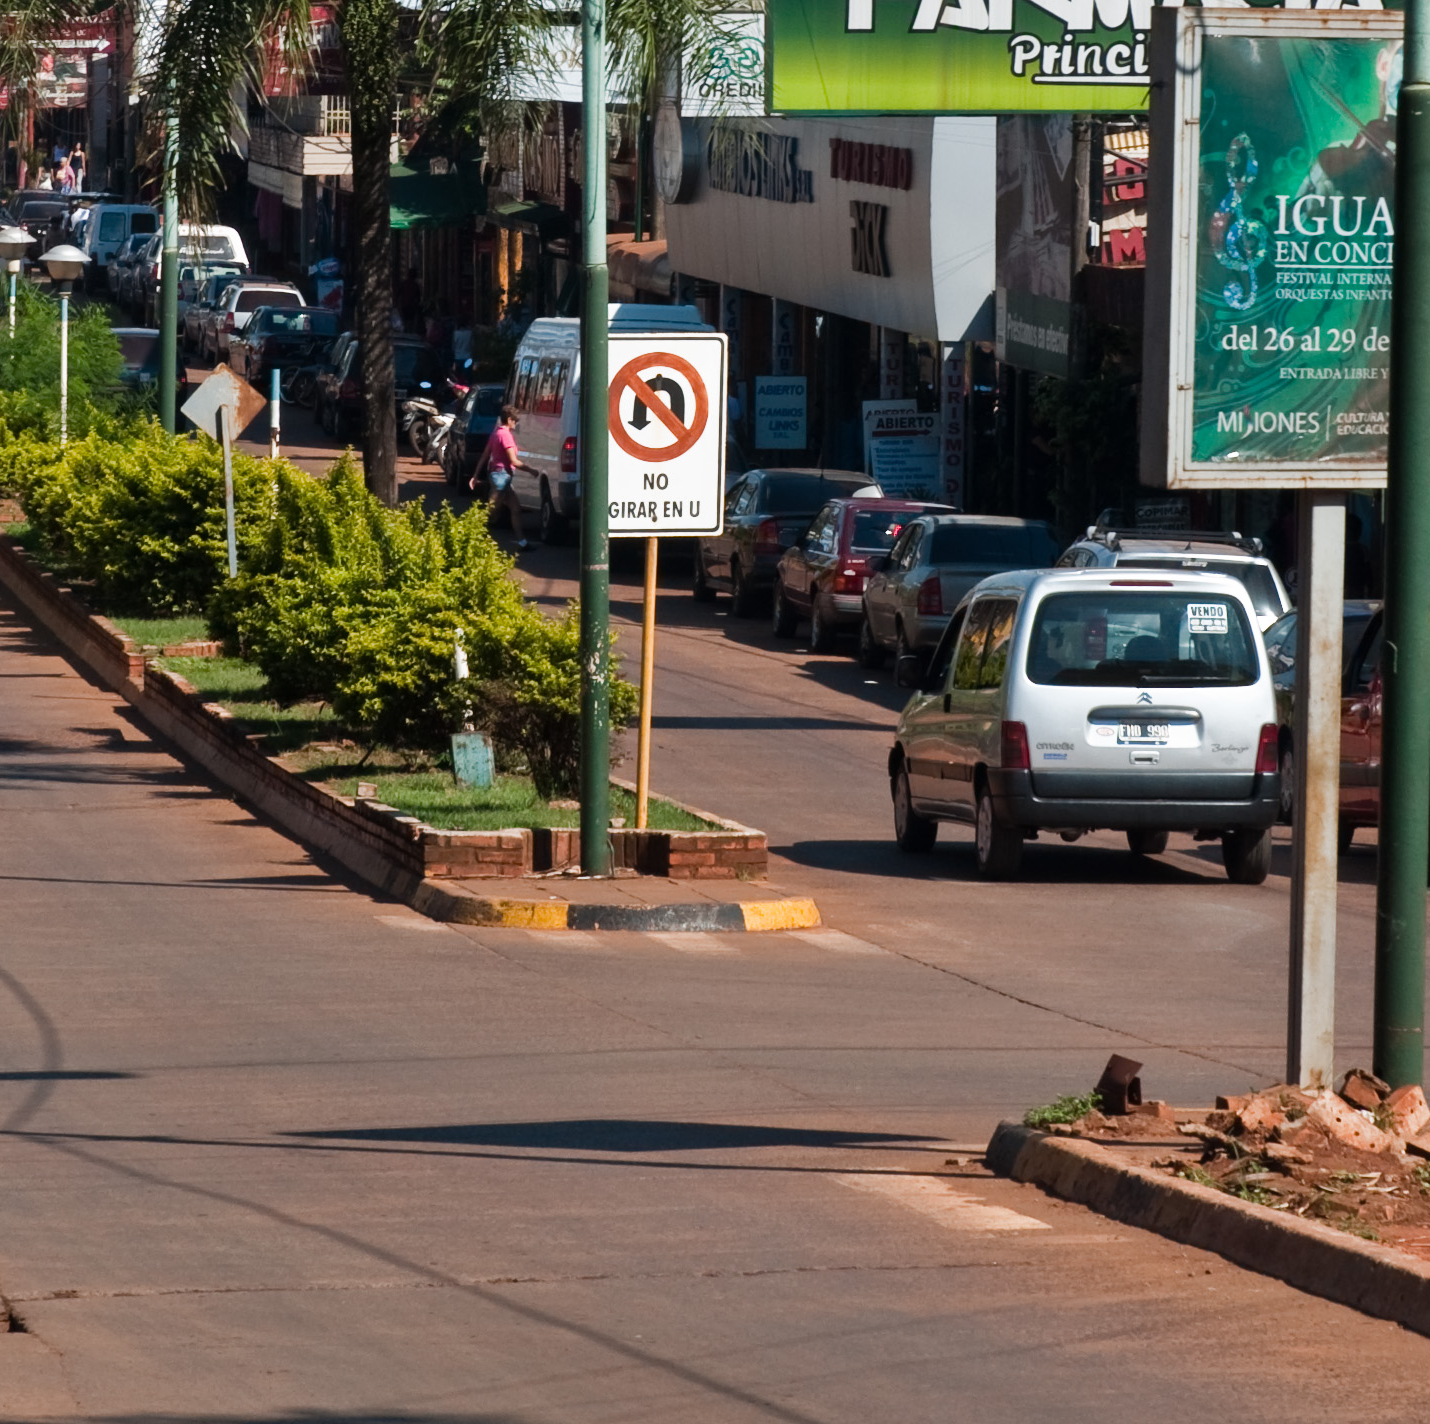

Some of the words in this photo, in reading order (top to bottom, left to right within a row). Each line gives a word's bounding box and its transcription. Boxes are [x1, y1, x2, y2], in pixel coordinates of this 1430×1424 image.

[1009, 33, 1150, 76] Princi
[829, 137, 913, 191] TURISMO
[1275, 241, 1308, 262] EN
[1276, 273, 1334, 284] FESTIVAL
[1337, 273, 1392, 285] INTERNA
[1275, 288, 1344, 300] ORQUESTAS
[1222, 326, 1258, 351] del
[1263, 327, 1295, 351] 26
[1300, 326, 1321, 352] al
[1327, 328, 1356, 353] 29
[1363, 327, 1390, 352] de
[1279, 367, 1342, 379] ENTRADA
[1344, 367, 1379, 379] LIBRE
[758, 384, 805, 396] ABIERTO
[759, 407, 804, 417] CAMBIOS
[945, 359, 963, 466] TURISMO
[1336, 412, 1385, 423] CULTURA
[769, 420, 799, 431] LINKS
[875, 416, 934, 429] ABIERTO
[643, 473, 669, 490] NO
[608, 500, 657, 518] GIRAR
[664, 500, 683, 518] EN
[690, 500, 700, 518] U
[1190, 606, 1224, 618] VENDO
